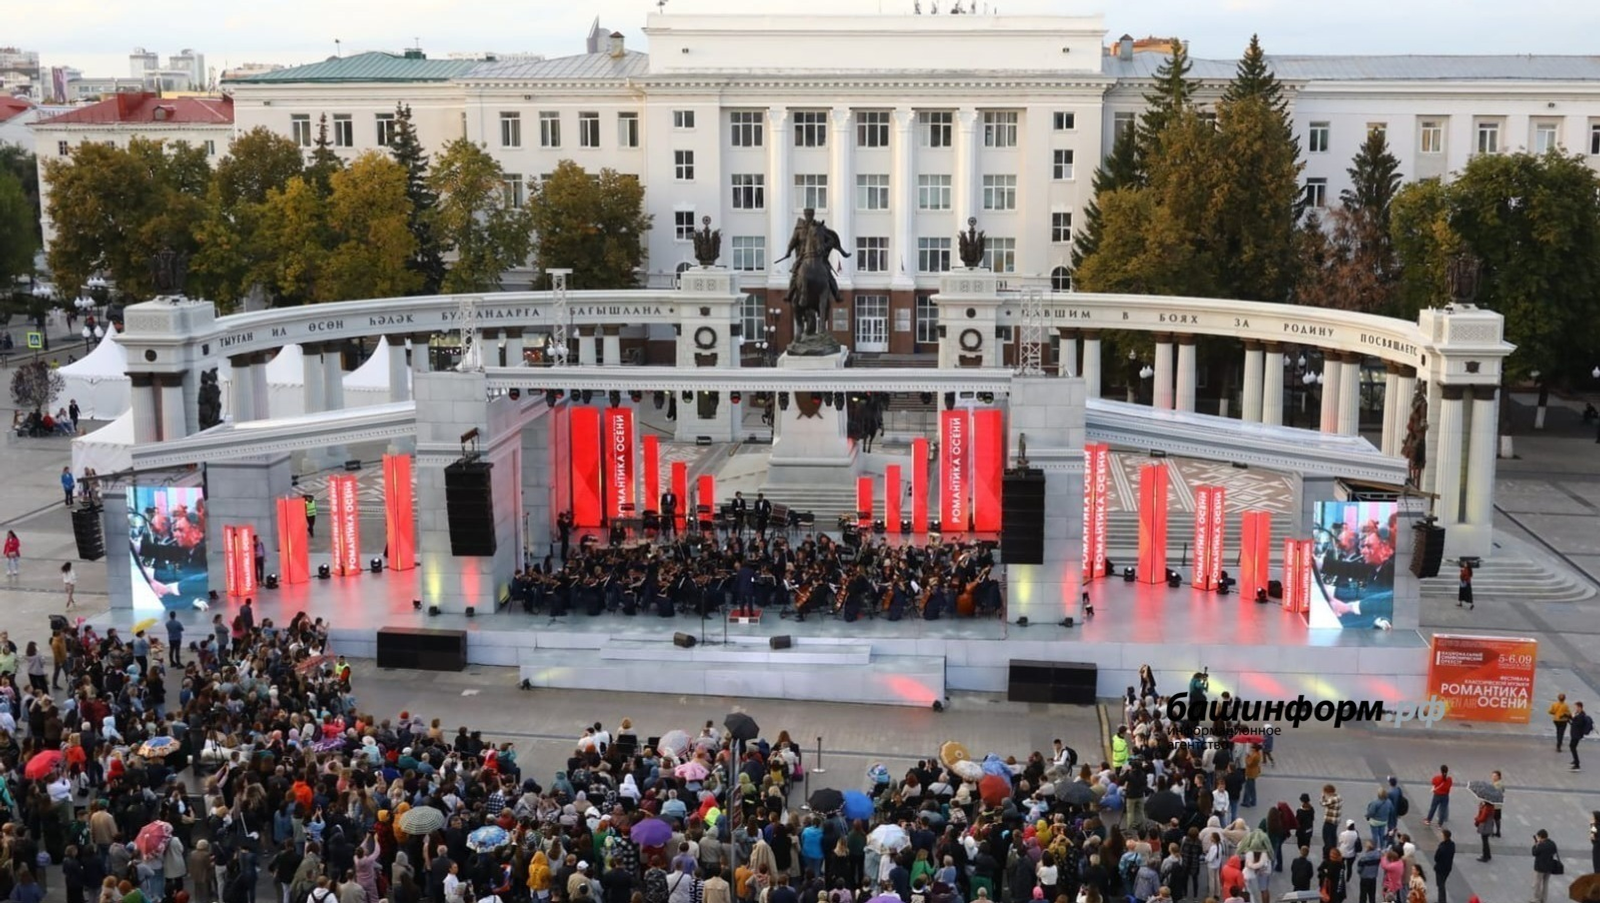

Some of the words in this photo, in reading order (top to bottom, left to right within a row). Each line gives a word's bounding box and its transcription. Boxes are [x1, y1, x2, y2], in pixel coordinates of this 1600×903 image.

[308, 320, 344, 332] ӨСӨН
[1122, 311, 1129, 320] В
[1159, 313, 1198, 323] БОЯХ
[1234, 318, 1250, 328] ЗА
[1284, 322, 1335, 337] РОДИНУ
[1360, 333, 1418, 357] ПОСВЯЩАЕТС
[616, 415, 625, 452] ОСЕНИ
[952, 418, 961, 455] ОСЕНИ
[616, 455, 626, 518] РОМАНТИКА
[1097, 451, 1106, 492] ОСЕНИ
[345, 481, 354, 512] ОСЕНИ
[952, 459, 961, 523] РОМАНТИКА
[1198, 492, 1207, 524] ОСЕНИ
[1214, 492, 1222, 524] ОСЕНИ
[347, 514, 357, 569] РОМАНТИКА
[1096, 497, 1105, 570] РОМАНТИКА
[1196, 527, 1205, 583] РОМАНТИКА
[1498, 653, 1532, 664] 5-6.09
[1440, 683, 1528, 698] РОМАНТИКА
[1477, 696, 1527, 709] ОСЕНИ
